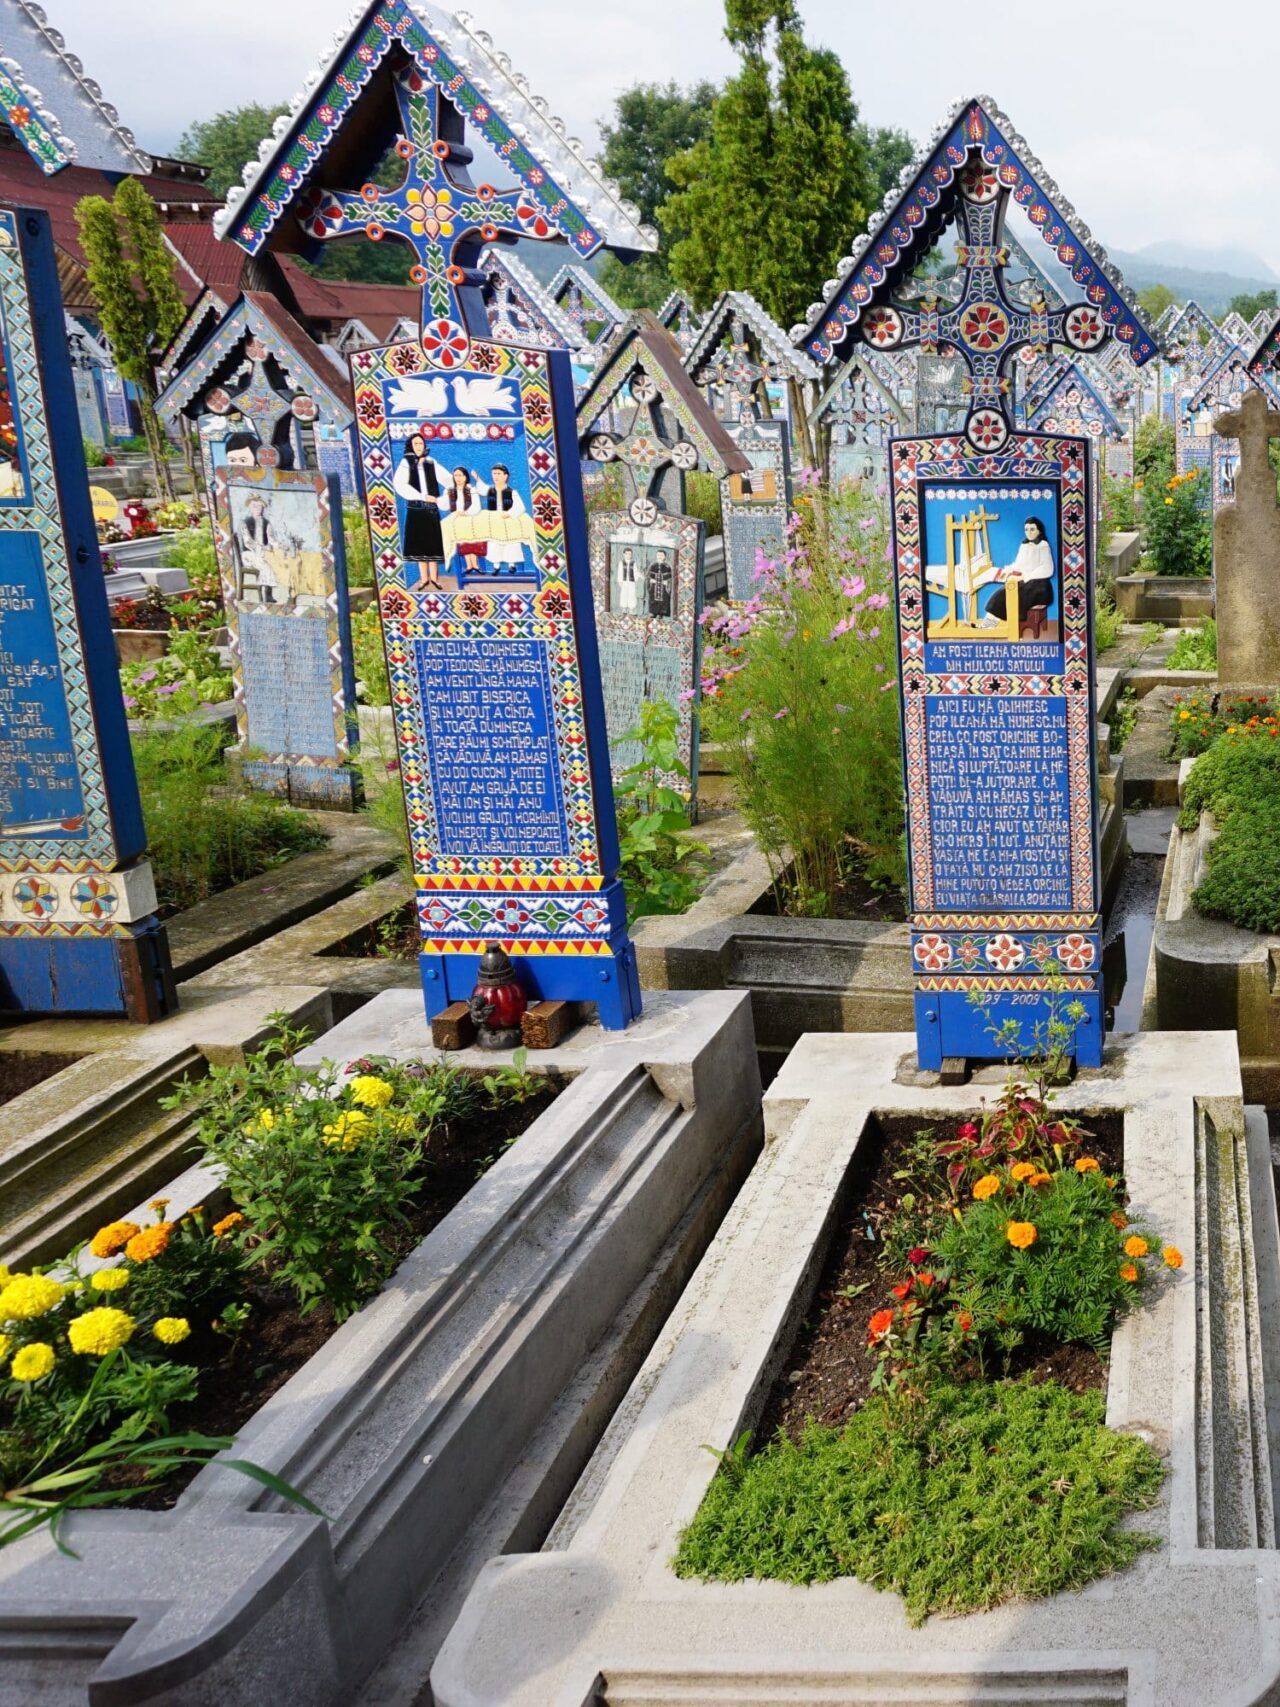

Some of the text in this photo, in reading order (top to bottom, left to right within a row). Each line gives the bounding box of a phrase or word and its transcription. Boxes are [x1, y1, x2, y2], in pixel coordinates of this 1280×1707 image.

[949, 646, 973, 658] FOST
[424, 659, 443, 671] POP
[1007, 660, 1045, 672] SATULUI
[443, 675, 473, 687] VENIT
[506, 676, 540, 688] MAMA
[451, 691, 478, 703] IUBIT
[481, 690, 531, 703] BISERICA
[493, 706, 504, 718] A
[938, 700, 959, 713] AICI
[962, 700, 976, 713] EU
[930, 715, 949, 728] POP
[433, 736, 458, 748] TARE
[973, 731, 997, 743] FOST
[982, 746, 1002, 758] SAT
[1003, 746, 1018, 758] CA
[439, 767, 451, 778] CU
[453, 767, 470, 779] DOI
[1034, 761, 1049, 773] LA
[440, 781, 468, 793] AVUT
[520, 782, 534, 794] DE
[535, 782, 546, 794] EI
[933, 820, 958, 832] CIOR
[961, 821, 975, 832] EU
[994, 820, 1020, 832] AVUT
[533, 841, 561, 853] TOATE
